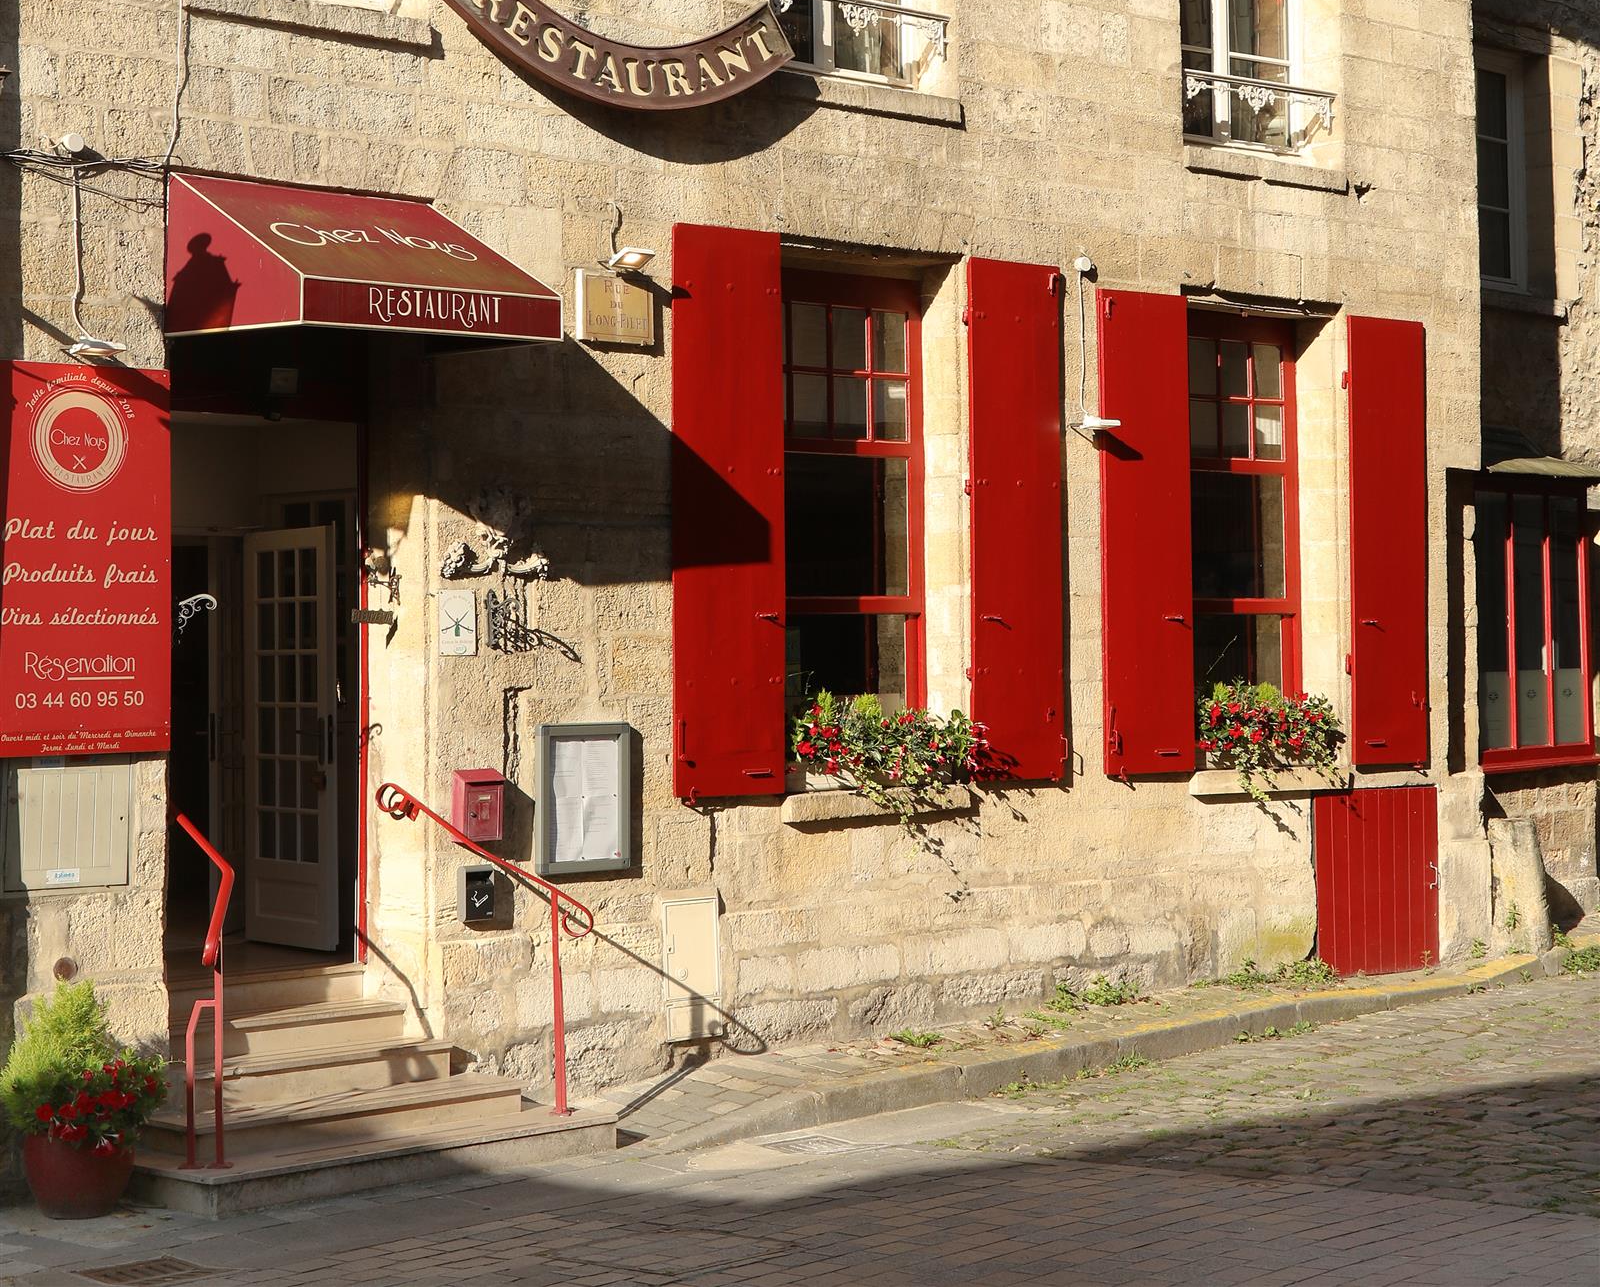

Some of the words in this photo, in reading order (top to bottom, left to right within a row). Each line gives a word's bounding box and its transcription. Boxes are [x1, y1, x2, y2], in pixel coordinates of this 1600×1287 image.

[270, 222, 380, 247] Chez
[374, 225, 478, 262] Nous
[604, 280, 631, 295] RUE
[369, 287, 502, 329] RESTAURANT
[25, 387, 46, 413] Table
[46, 372, 88, 392] familiale
[90, 376, 120, 399] depuis
[118, 399, 136, 419] 2018
[50, 428, 81, 446] Chez
[84, 432, 108, 452] Nous
[5, 518, 55, 542] Plat
[66, 519, 98, 540] du
[106, 520, 158, 546] jour
[2, 562, 97, 586] Produits
[103, 563, 159, 589] frais
[1, 608, 43, 626] Vins
[49, 606, 159, 626] sélectionnés
[25, 651, 136, 682] Réservation
[15, 693, 37, 709] 03
[42, 692, 65, 708] 44
[70, 691, 91, 707] 60
[97, 691, 118, 707] 95
[123, 690, 144, 706] 50
[1, 734, 24, 742] Ouvert
[25, 732, 41, 741] midi
[79, 730, 111, 739] Mercredi
[124, 729, 157, 738] Dimanche
[65, 742, 86, 751] Lundi
[96, 741, 120, 750] Mardi
